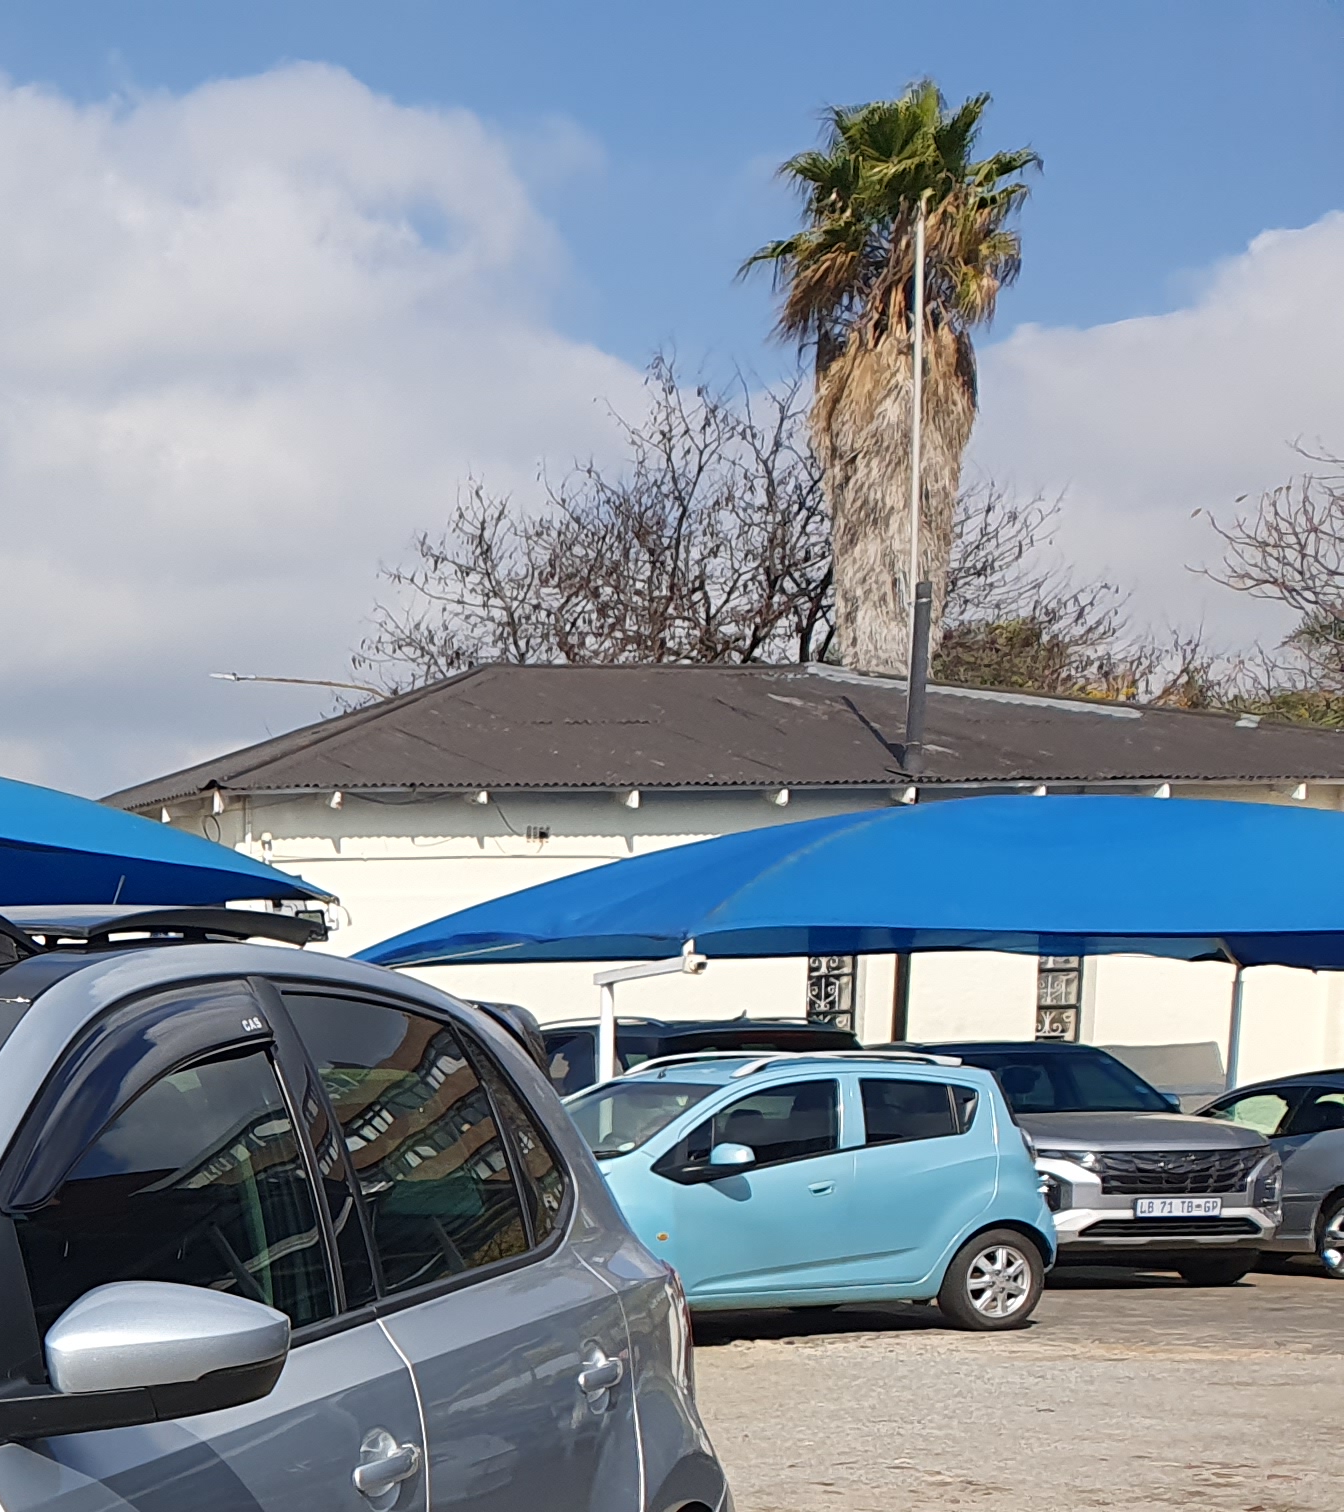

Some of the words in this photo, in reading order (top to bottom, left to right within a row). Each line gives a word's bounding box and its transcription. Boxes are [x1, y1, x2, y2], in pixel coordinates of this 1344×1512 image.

[1139, 1200, 1155, 1214] LB
[1159, 1200, 1174, 1214] 71
[1203, 1200, 1219, 1214] GP
